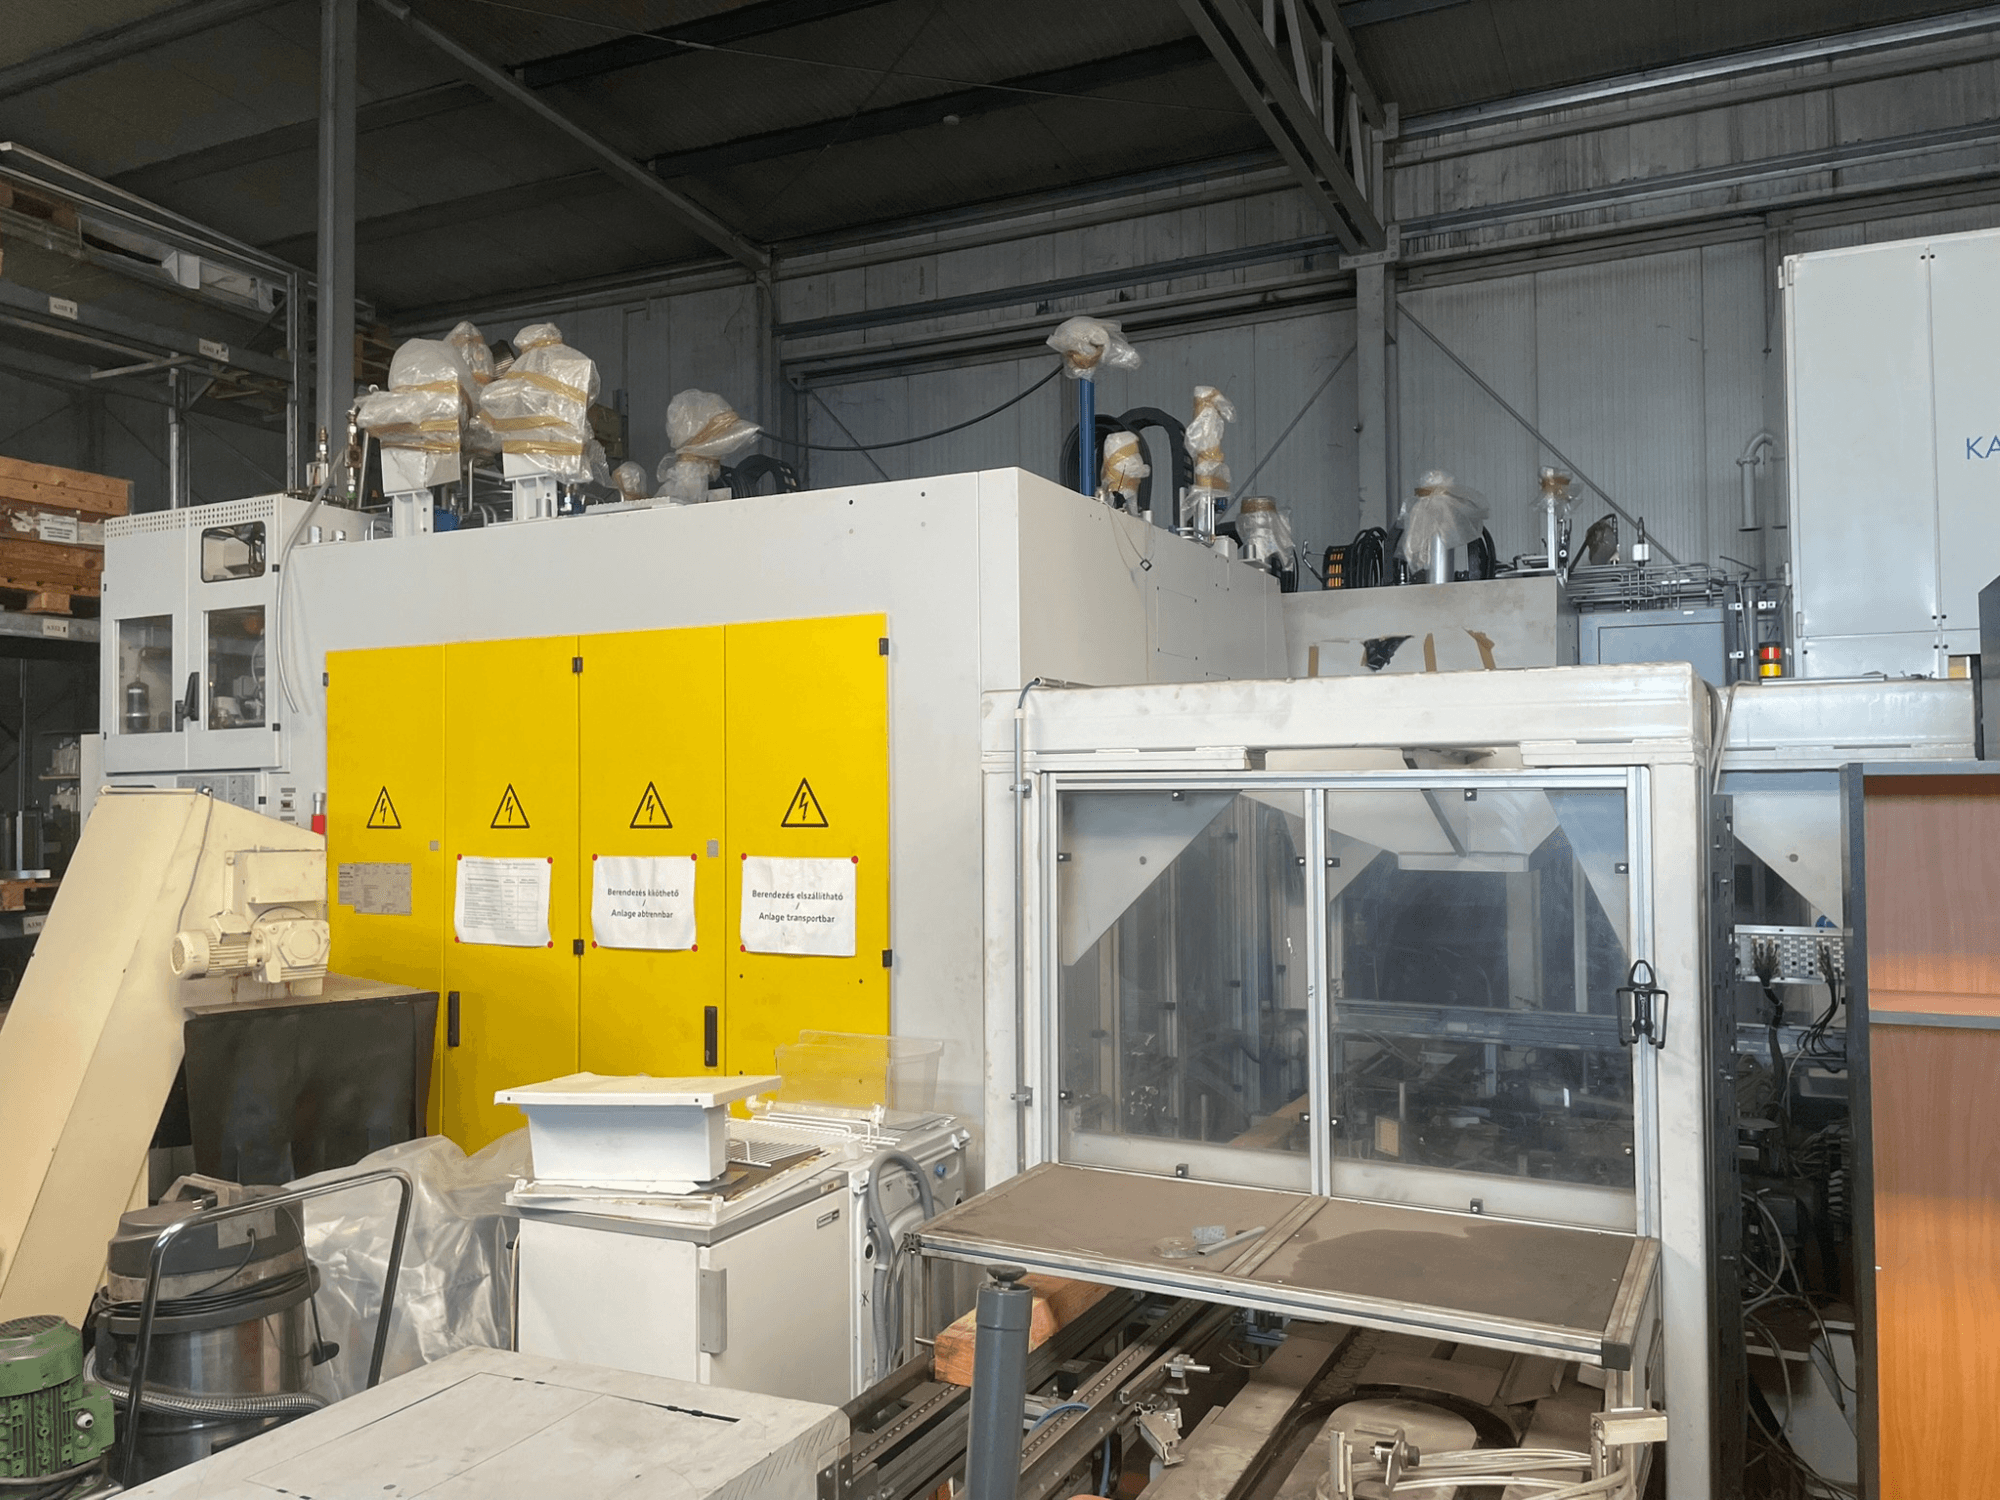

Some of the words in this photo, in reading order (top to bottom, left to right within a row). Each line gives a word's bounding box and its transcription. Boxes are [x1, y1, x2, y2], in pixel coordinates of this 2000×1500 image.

[607, 888, 646, 897] Berendezés
[752, 889, 795, 899] Berendezés
[611, 909, 636, 919] Anlage
[637, 910, 674, 918] abtrennbar
[759, 912, 785, 923] Anlage
[786, 914, 836, 924] transportbar
